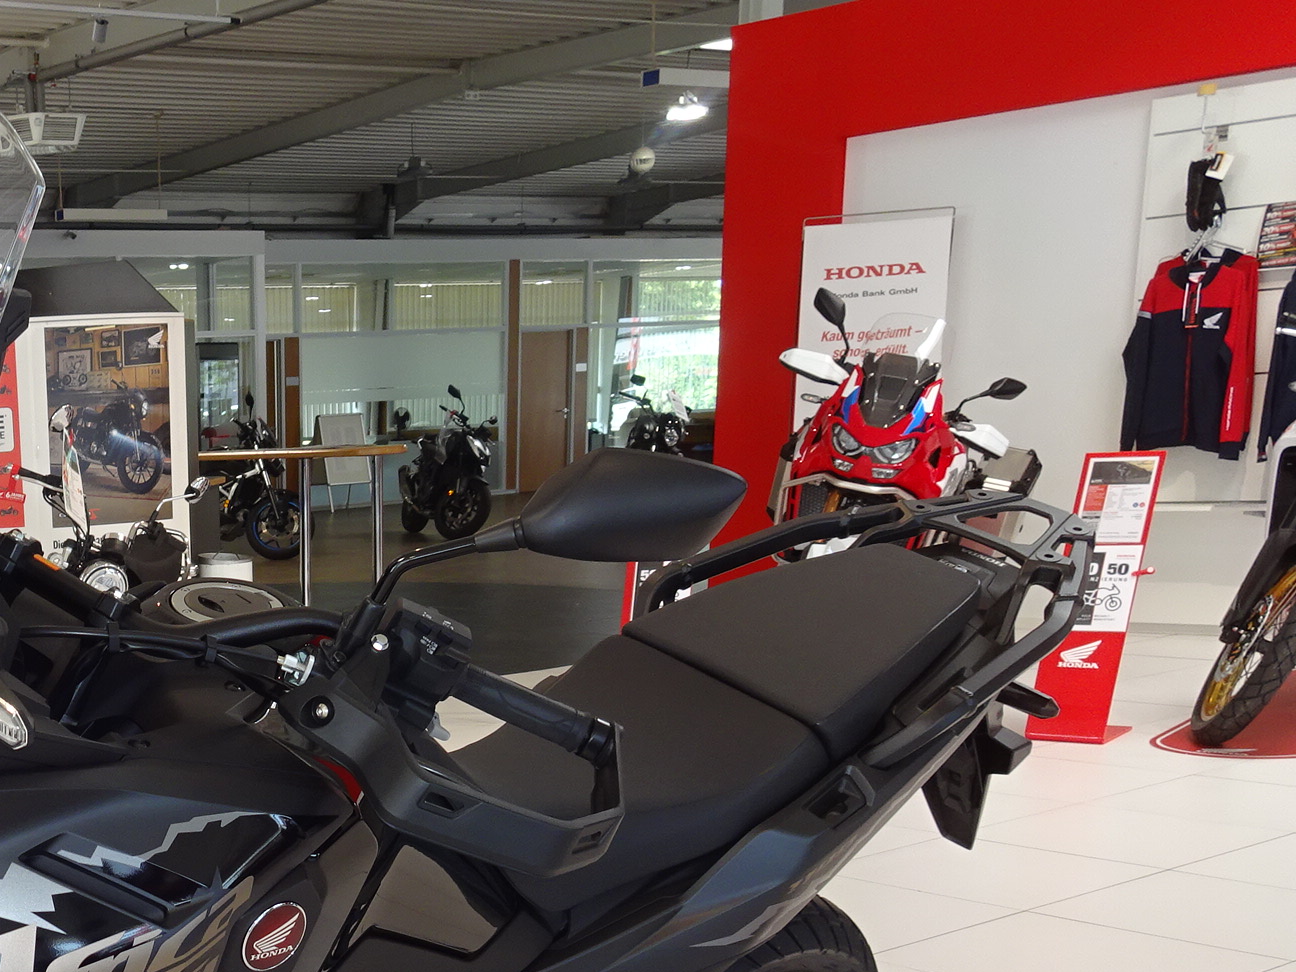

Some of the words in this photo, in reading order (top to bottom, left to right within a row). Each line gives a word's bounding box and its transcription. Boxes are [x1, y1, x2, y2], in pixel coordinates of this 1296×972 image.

[824, 262, 926, 280] HONDA
[834, 291, 859, 299] onda
[862, 289, 886, 297] Bank
[889, 287, 918, 296] GmbH
[821, 330, 854, 343] Kaum
[1107, 563, 1130, 575] 50
[1056, 661, 1099, 669] HONDA
[250, 945, 294, 961] HONDA
